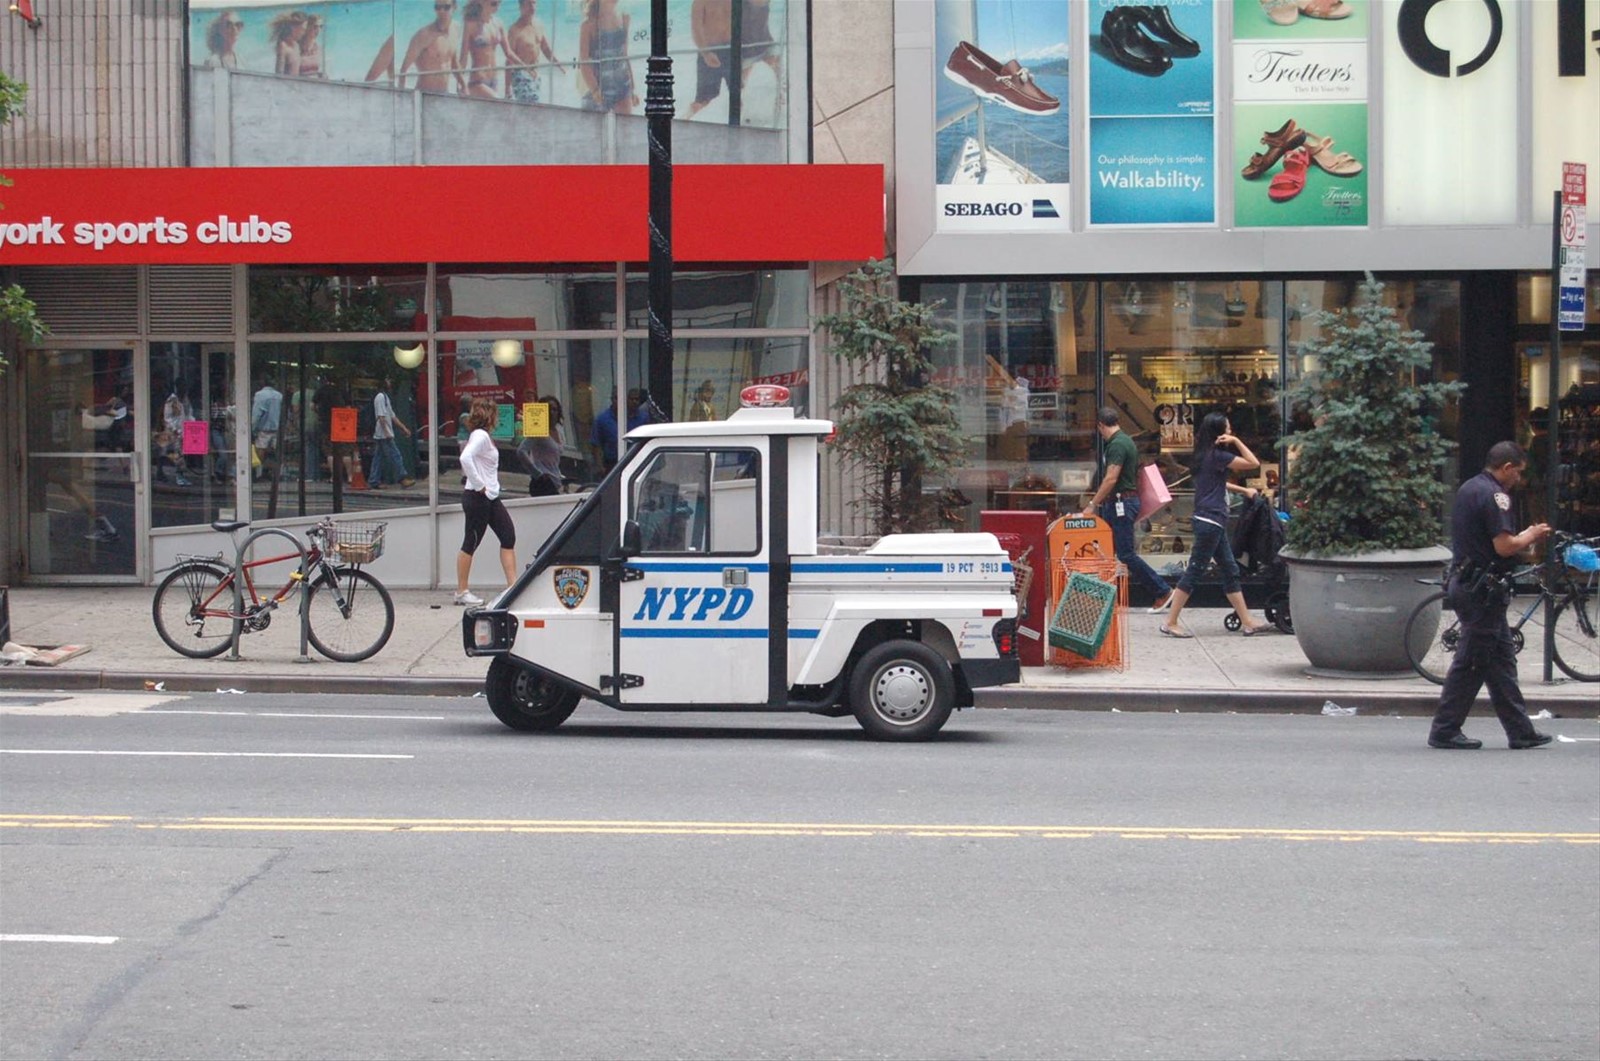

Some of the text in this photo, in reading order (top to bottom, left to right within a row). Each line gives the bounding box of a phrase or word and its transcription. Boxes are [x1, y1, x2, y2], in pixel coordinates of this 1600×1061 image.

[1248, 49, 1352, 83] Trotters
[1098, 154, 1206, 167] Our philosophy is simple:
[1099, 171, 1205, 191] Walkability.
[944, 203, 1023, 216] SEBAGO
[0, 215, 292, 250] york sports clubs
[1065, 519, 1096, 528] metro
[946, 562, 955, 573] 19
[958, 562, 974, 573] PCT
[632, 587, 754, 621] NYPD
